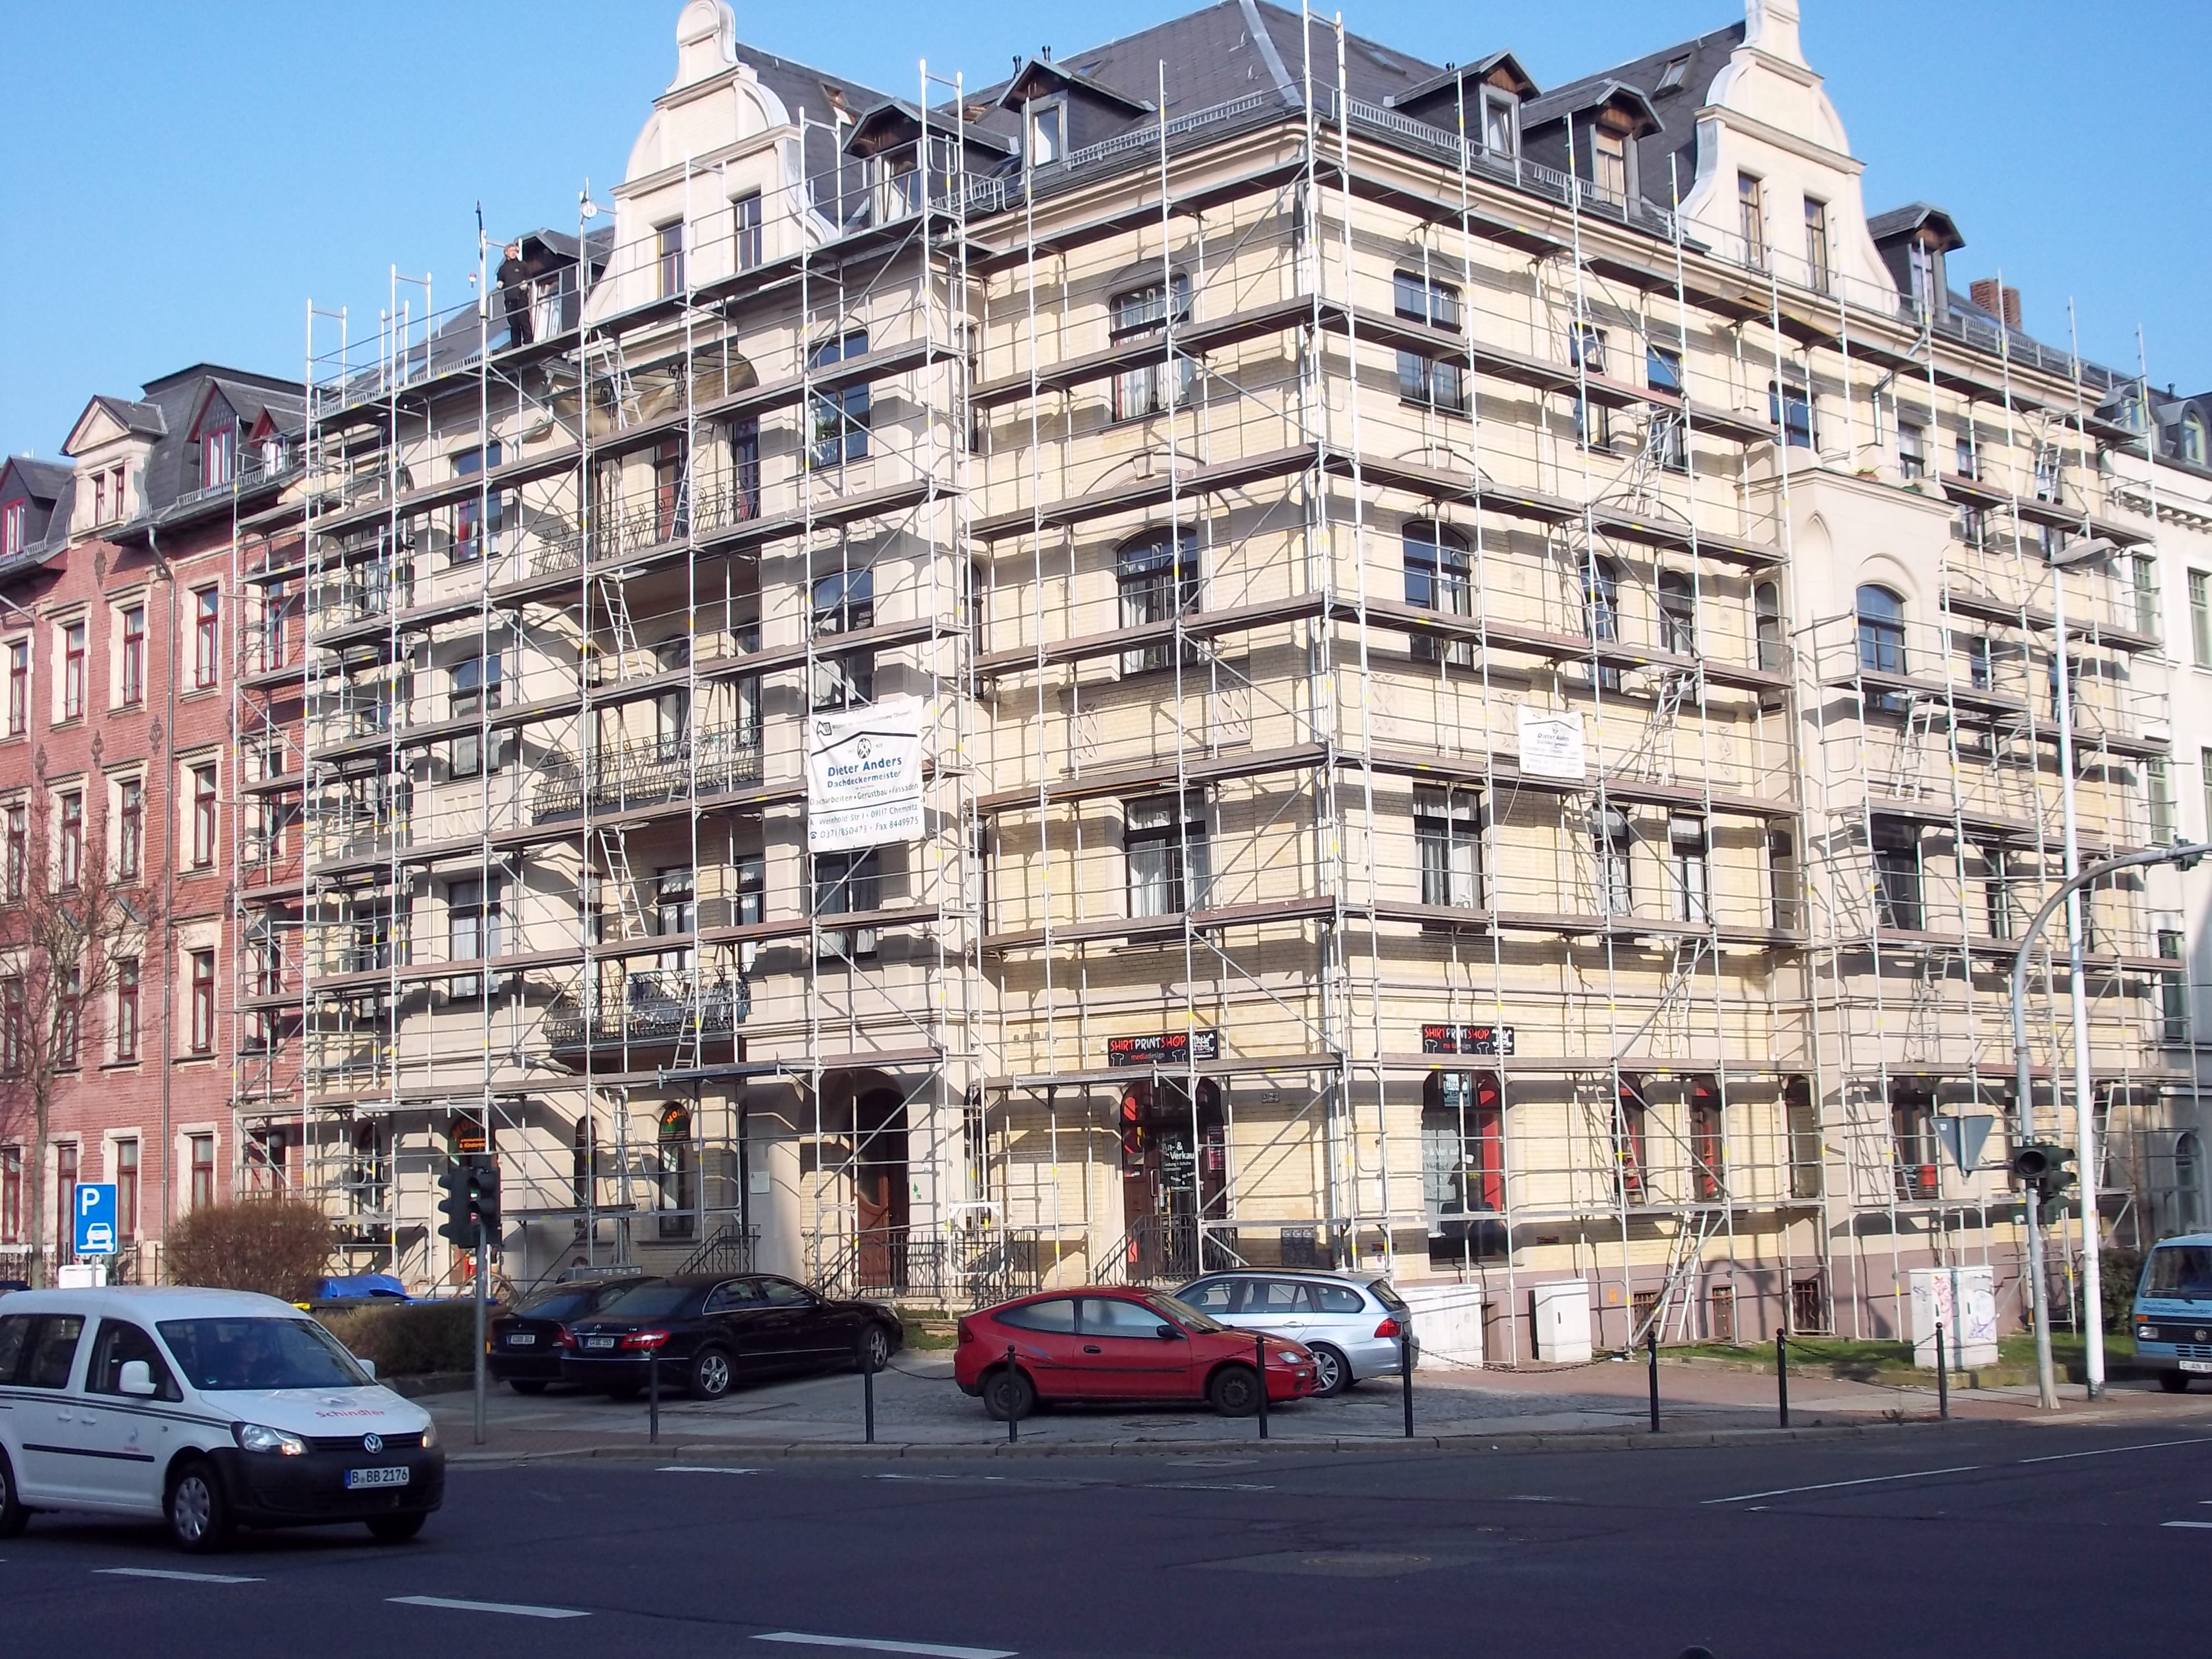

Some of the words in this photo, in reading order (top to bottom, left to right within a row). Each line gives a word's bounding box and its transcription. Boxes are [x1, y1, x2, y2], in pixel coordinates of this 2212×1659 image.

[828, 764, 859, 776] Dieter
[863, 757, 902, 771] Anders
[827, 770, 901, 787] Dachdeckermeister
[889, 804, 918, 815] Chemnitz
[876, 822, 887, 831] Fax
[889, 816, 919, 828] 8449975
[1177, 1141, 1183, 1150] &
[1170, 1151, 1194, 1160] Verkau
[82, 1188, 100, 1216] P
[315, 1410, 385, 1418] Schindler
[352, 1471, 359, 1484] B
[367, 1470, 380, 1483] BB
[383, 1468, 408, 1481] 2176
